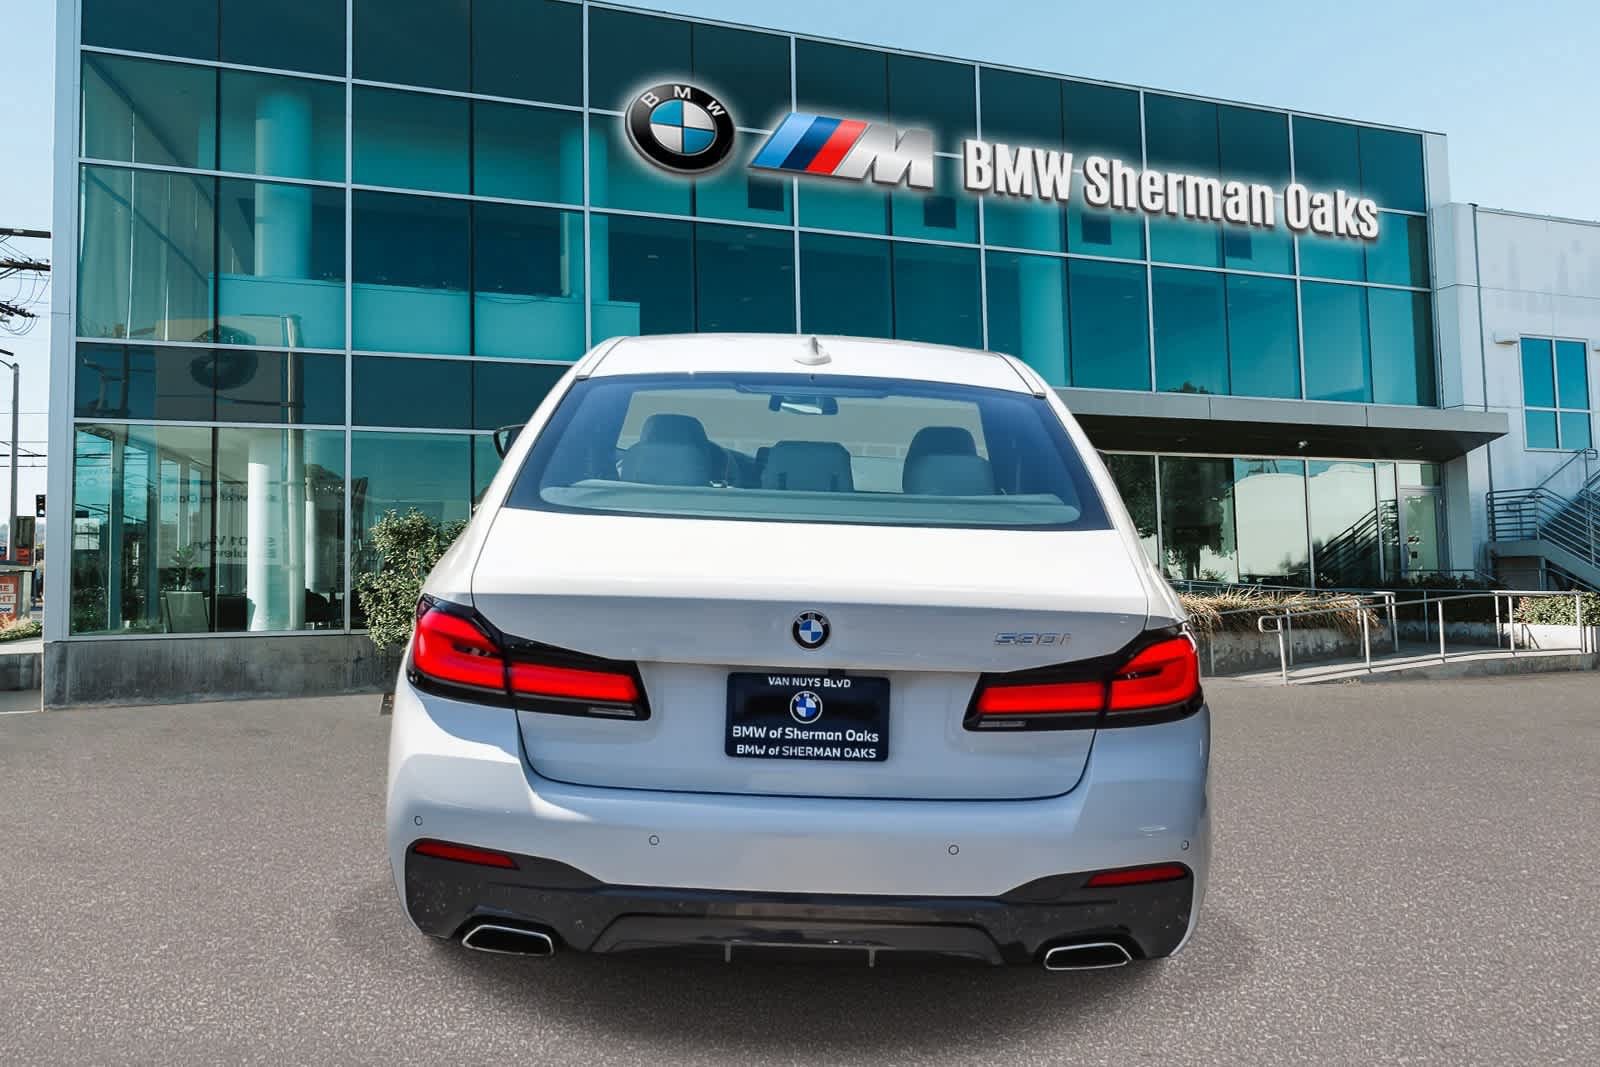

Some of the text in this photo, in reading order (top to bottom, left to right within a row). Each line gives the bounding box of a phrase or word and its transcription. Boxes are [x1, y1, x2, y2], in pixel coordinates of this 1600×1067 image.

[963, 139, 1380, 241] BMW Sherman Oaks
[768, 676, 851, 688] VAN NUYS BLVD
[732, 725, 879, 743] BMW of Sherman Oaks
[736, 744, 877, 759] BMW of SHERMAN OAKS
